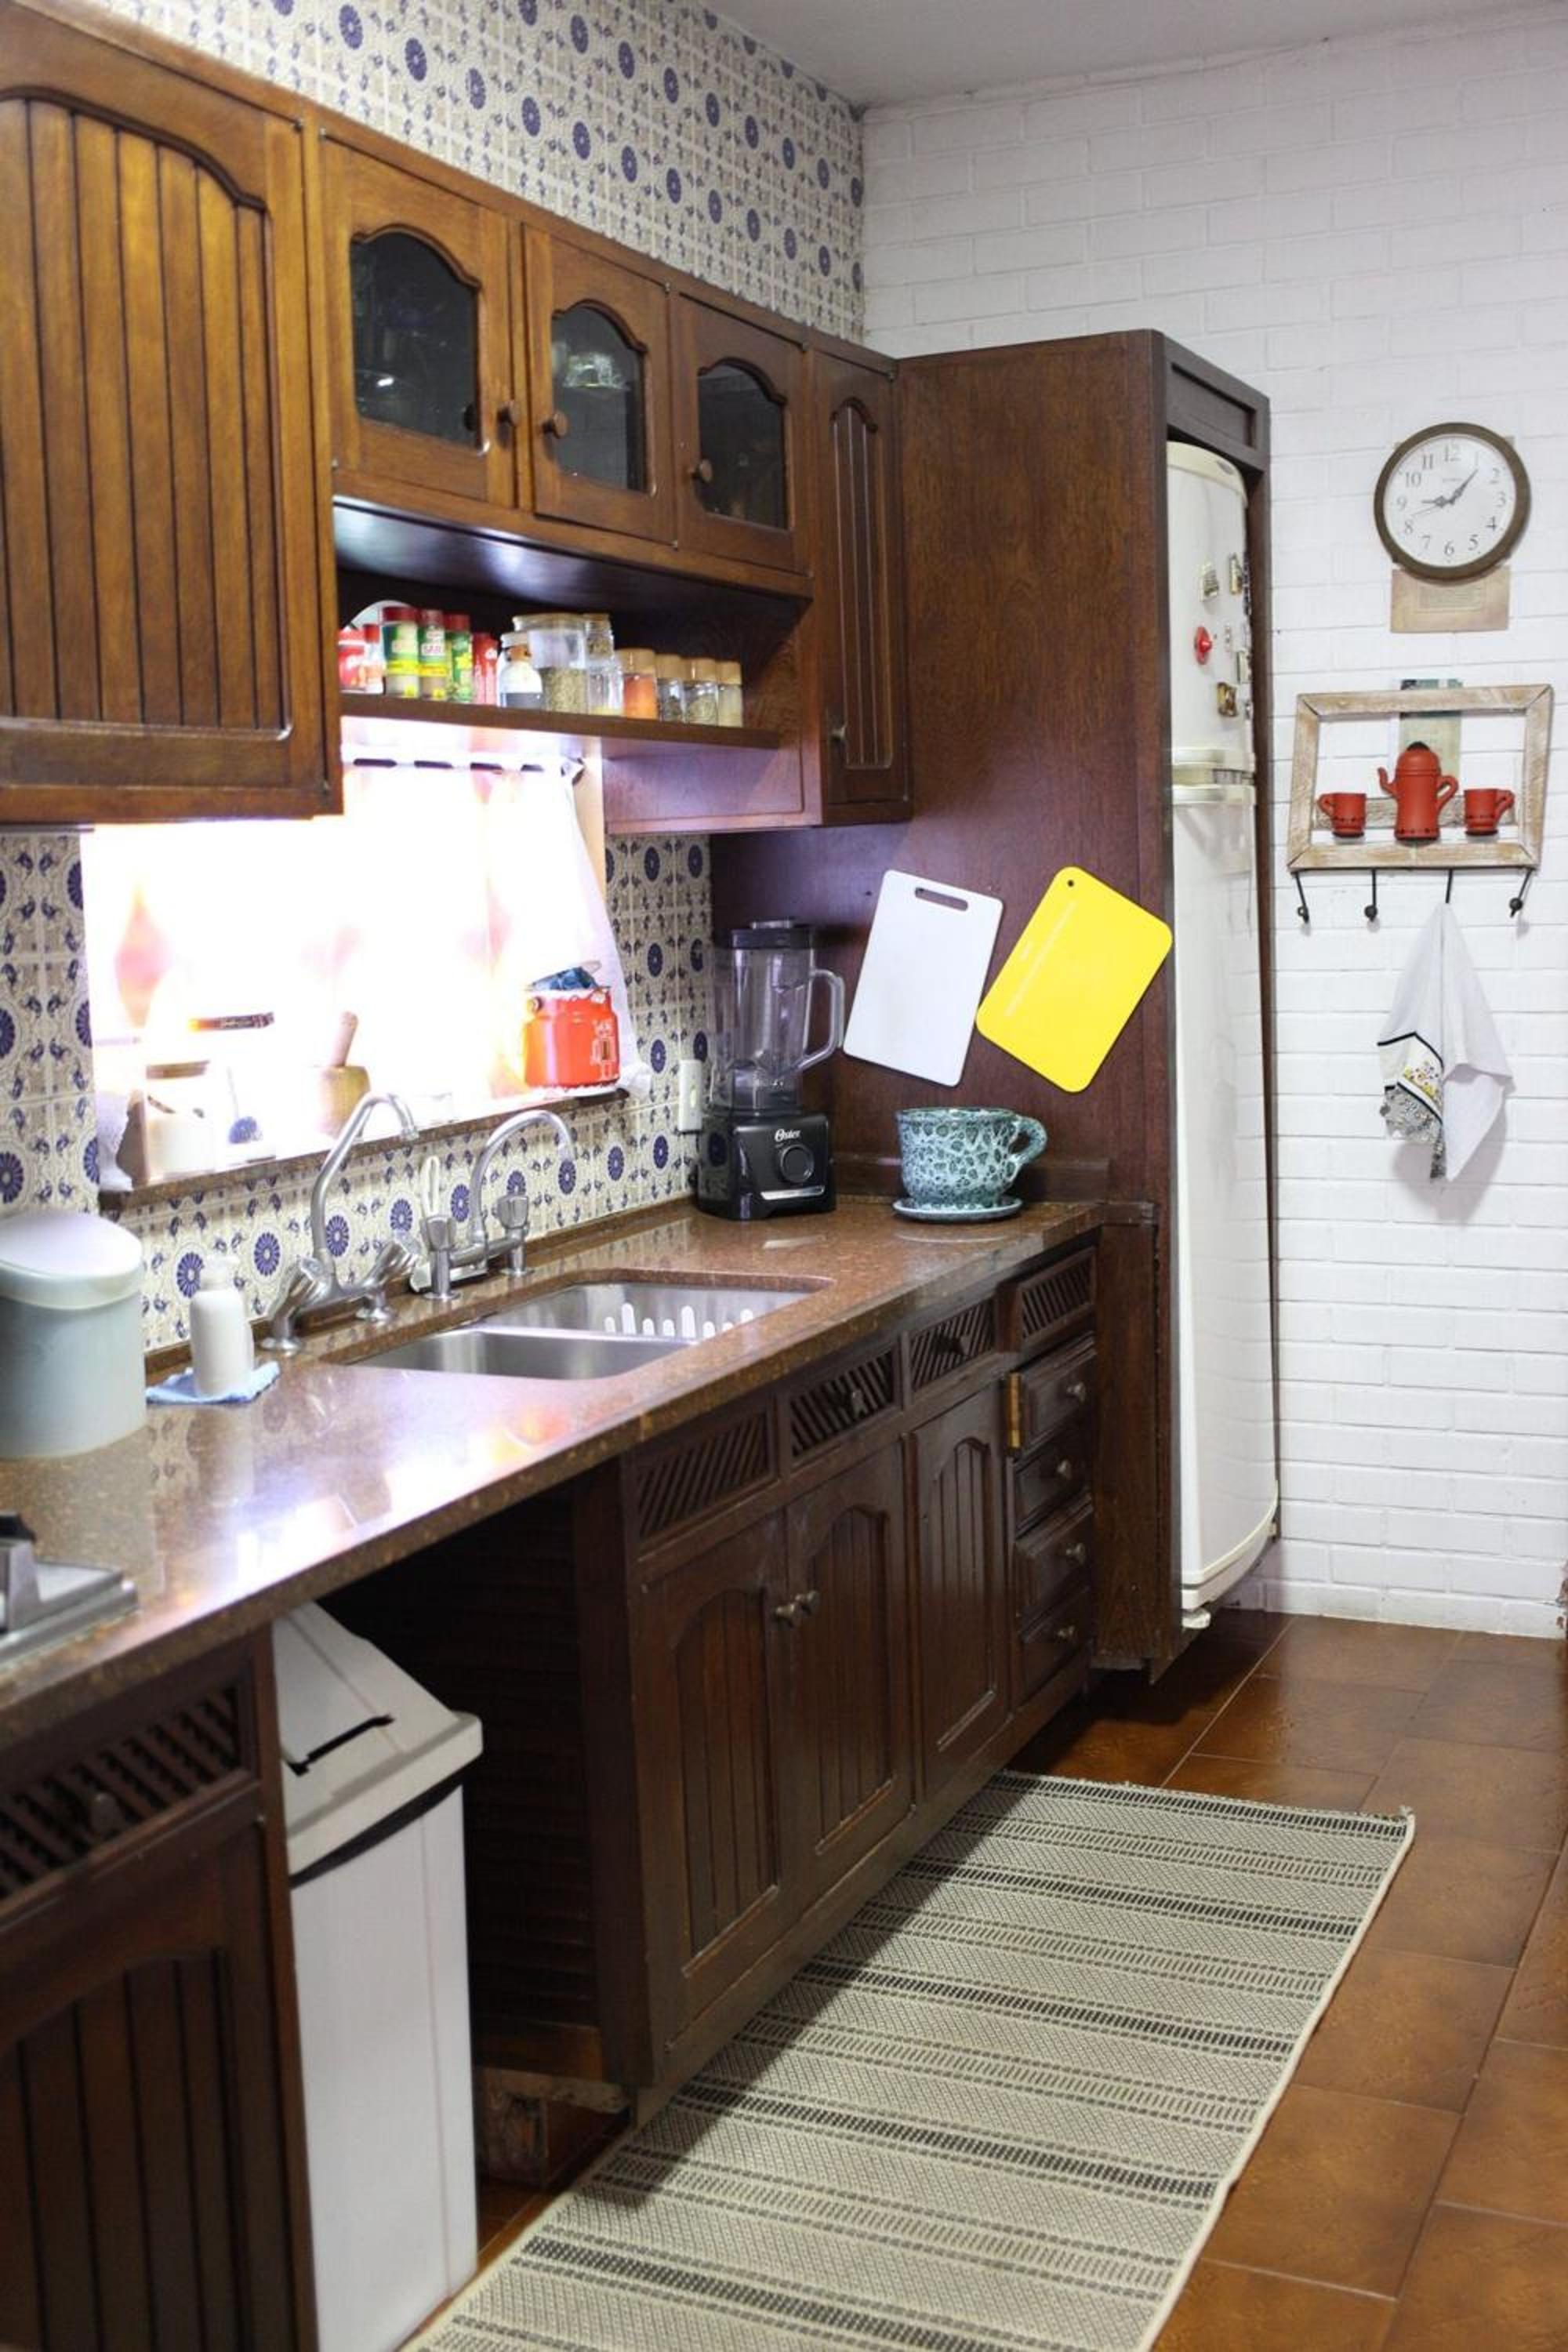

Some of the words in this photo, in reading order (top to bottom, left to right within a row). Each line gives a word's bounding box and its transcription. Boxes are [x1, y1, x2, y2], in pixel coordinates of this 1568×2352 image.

[1422, 454, 1434, 470] 11
[1443, 445, 1461, 463] 12
[1405, 472, 1421, 488] 10
[1490, 468, 1500, 485] 2
[1396, 496, 1407, 511] 9
[1497, 492, 1507, 509] 3
[1404, 519, 1414, 535] 8
[1486, 516, 1497, 532] 4
[1421, 535, 1432, 550] 7
[1444, 540, 1454, 557] 6
[1468, 533, 1479, 551] 5
[774, 1128, 801, 1142] Oster
